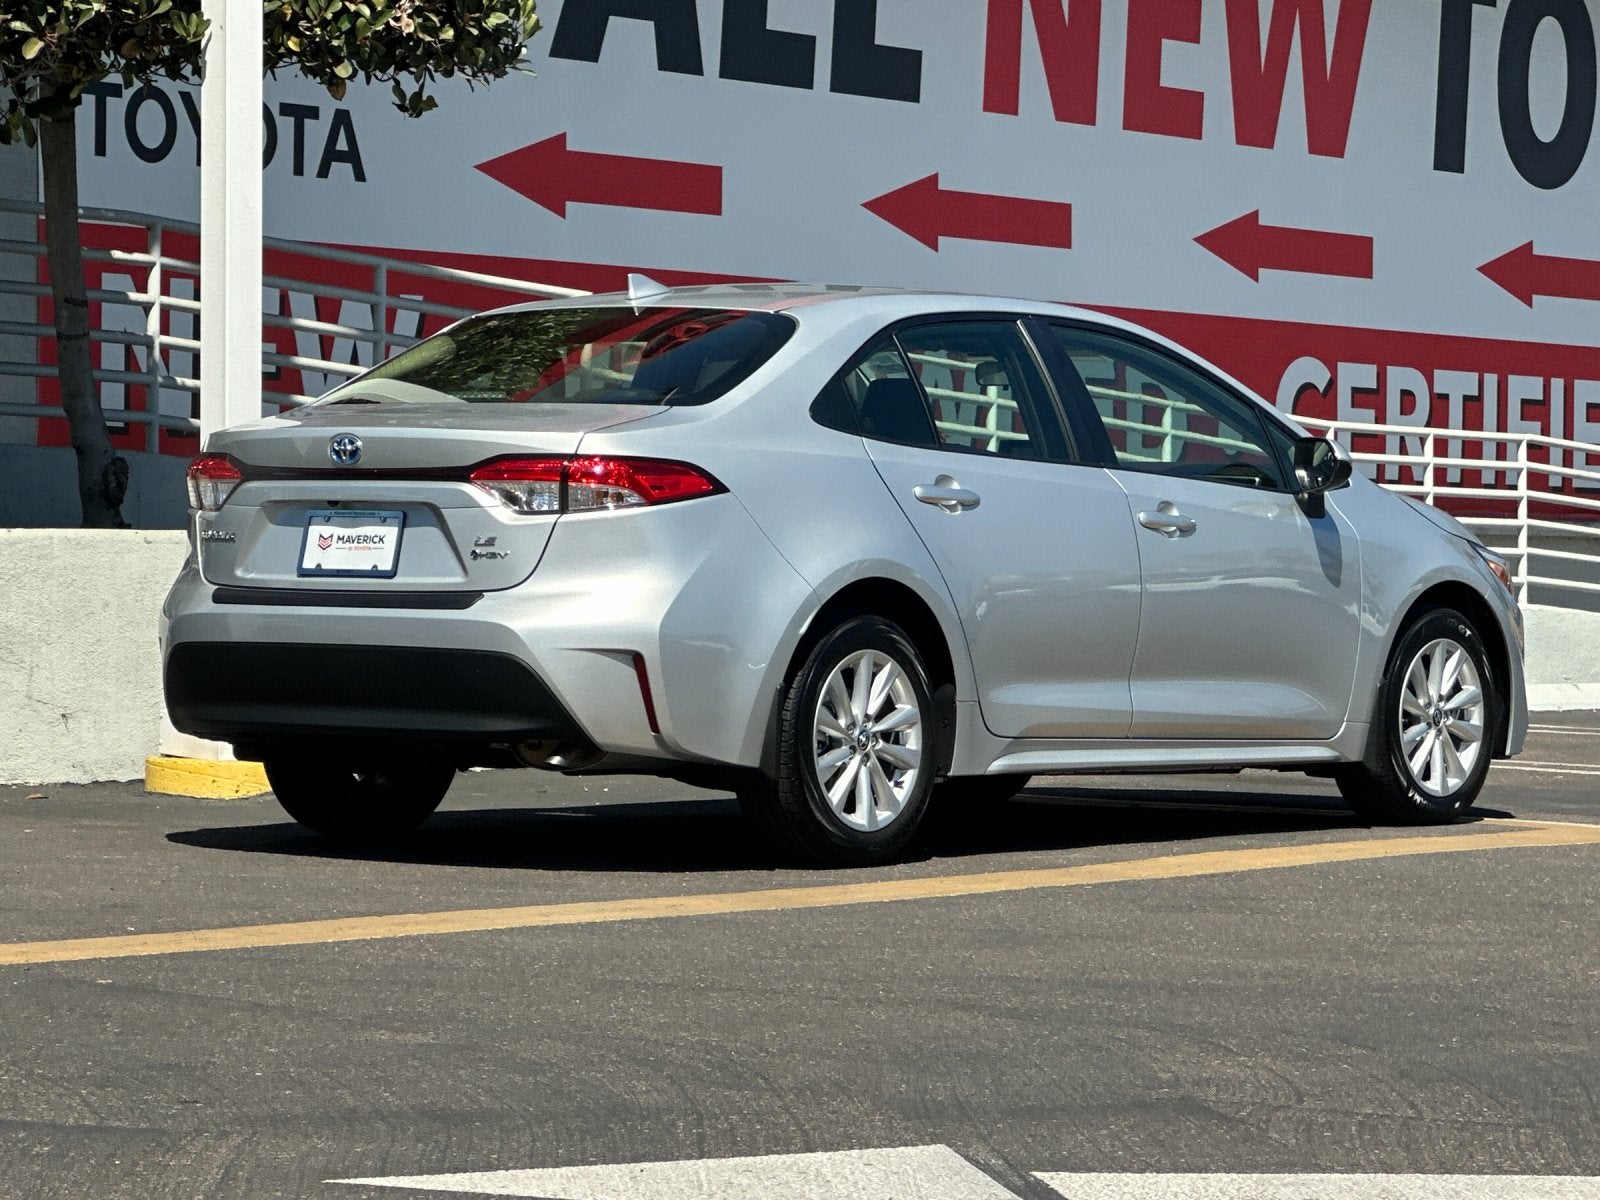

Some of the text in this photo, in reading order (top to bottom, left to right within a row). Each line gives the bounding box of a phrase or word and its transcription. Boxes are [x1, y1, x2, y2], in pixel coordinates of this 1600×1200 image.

[81, 80, 368, 183] TOYTA
[982, 0, 1373, 159] NEW
[101, 272, 424, 428] NW
[336, 534, 386, 545] MAVERICK
